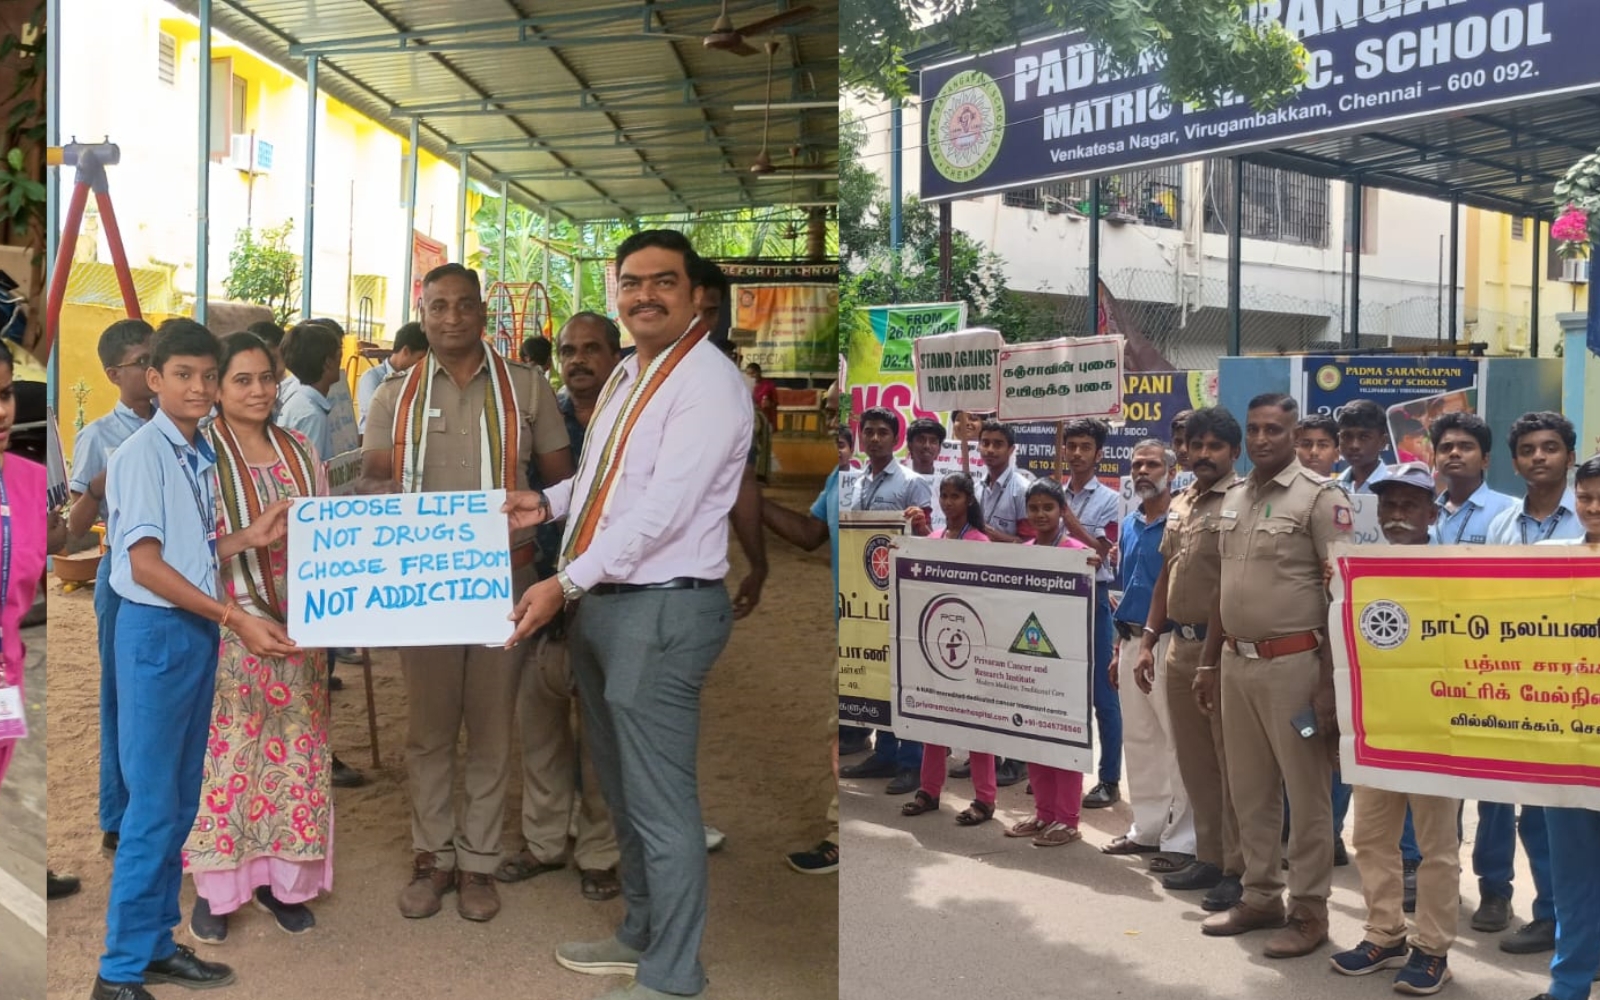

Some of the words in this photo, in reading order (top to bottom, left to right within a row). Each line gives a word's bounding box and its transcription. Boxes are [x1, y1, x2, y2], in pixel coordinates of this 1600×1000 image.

[1354, 2, 1552, 80] SCHOOL
[1043, 82, 1172, 141] MATRIC
[1050, 139, 1125, 163] Venkatesa
[1129, 130, 1180, 150] Nagar,
[1184, 102, 1332, 140] Virugambakkam,
[1338, 81, 1422, 112] Chennai
[1447, 69, 1486, 92] 600
[1492, 59, 1540, 84] 092.
[906, 312, 942, 325] FROM
[920, 351, 951, 369] STAND
[954, 349, 1000, 368] AGAINST
[1079, 359, 1116, 373] புகை
[1345, 367, 1383, 376] PADMA
[1385, 367, 1461, 377] SARANGAPANI
[927, 375, 957, 393] DRUG
[958, 373, 991, 390] ABUSE
[1075, 381, 1112, 393] பகை
[296, 498, 403, 523] CHOOSE
[417, 493, 489, 516] LIFE
[313, 526, 362, 552] NOT
[372, 522, 476, 547] DRUGS
[297, 558, 387, 581] CHOOSE
[399, 549, 510, 576] FREEDOM
[924, 564, 978, 582] Privaram
[980, 571, 1023, 586] Cancer
[1025, 574, 1076, 592] Hospital
[304, 586, 358, 624] NOT
[365, 576, 510, 610] ADDICTION
[1421, 613, 1490, 641] நாட்டு
[974, 655, 1005, 669] Privaram
[1007, 661, 1032, 672] Cancer
[1034, 665, 1048, 674] and
[1464, 654, 1522, 675] பத்மா
[974, 668, 1005, 680] Research
[1006, 673, 1036, 684] Institute
[1430, 680, 1511, 701] மெட்ரிக்
